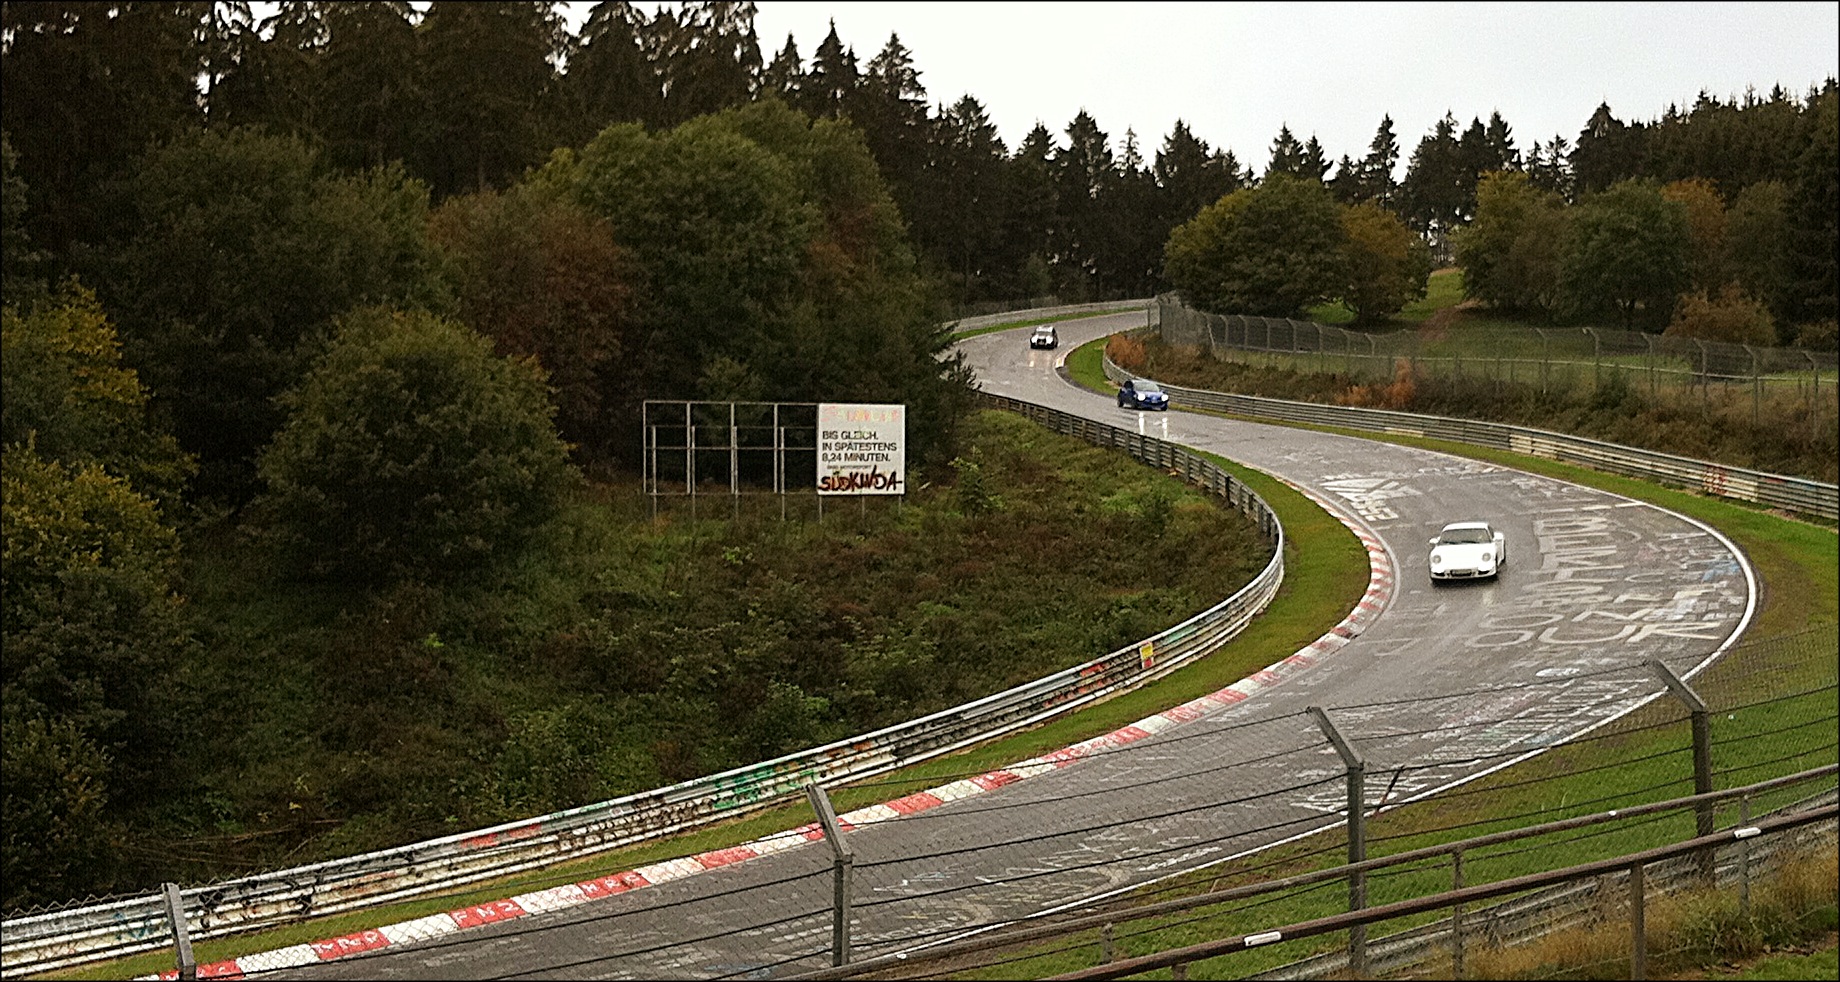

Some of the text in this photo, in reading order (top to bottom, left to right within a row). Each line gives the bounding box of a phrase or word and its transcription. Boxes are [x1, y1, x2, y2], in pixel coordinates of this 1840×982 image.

[822, 430, 879, 440] BIS GLEICH.
[822, 440, 897, 451] IN SPÄTESTENS
[844, 452, 891, 462] MINUTEN.
